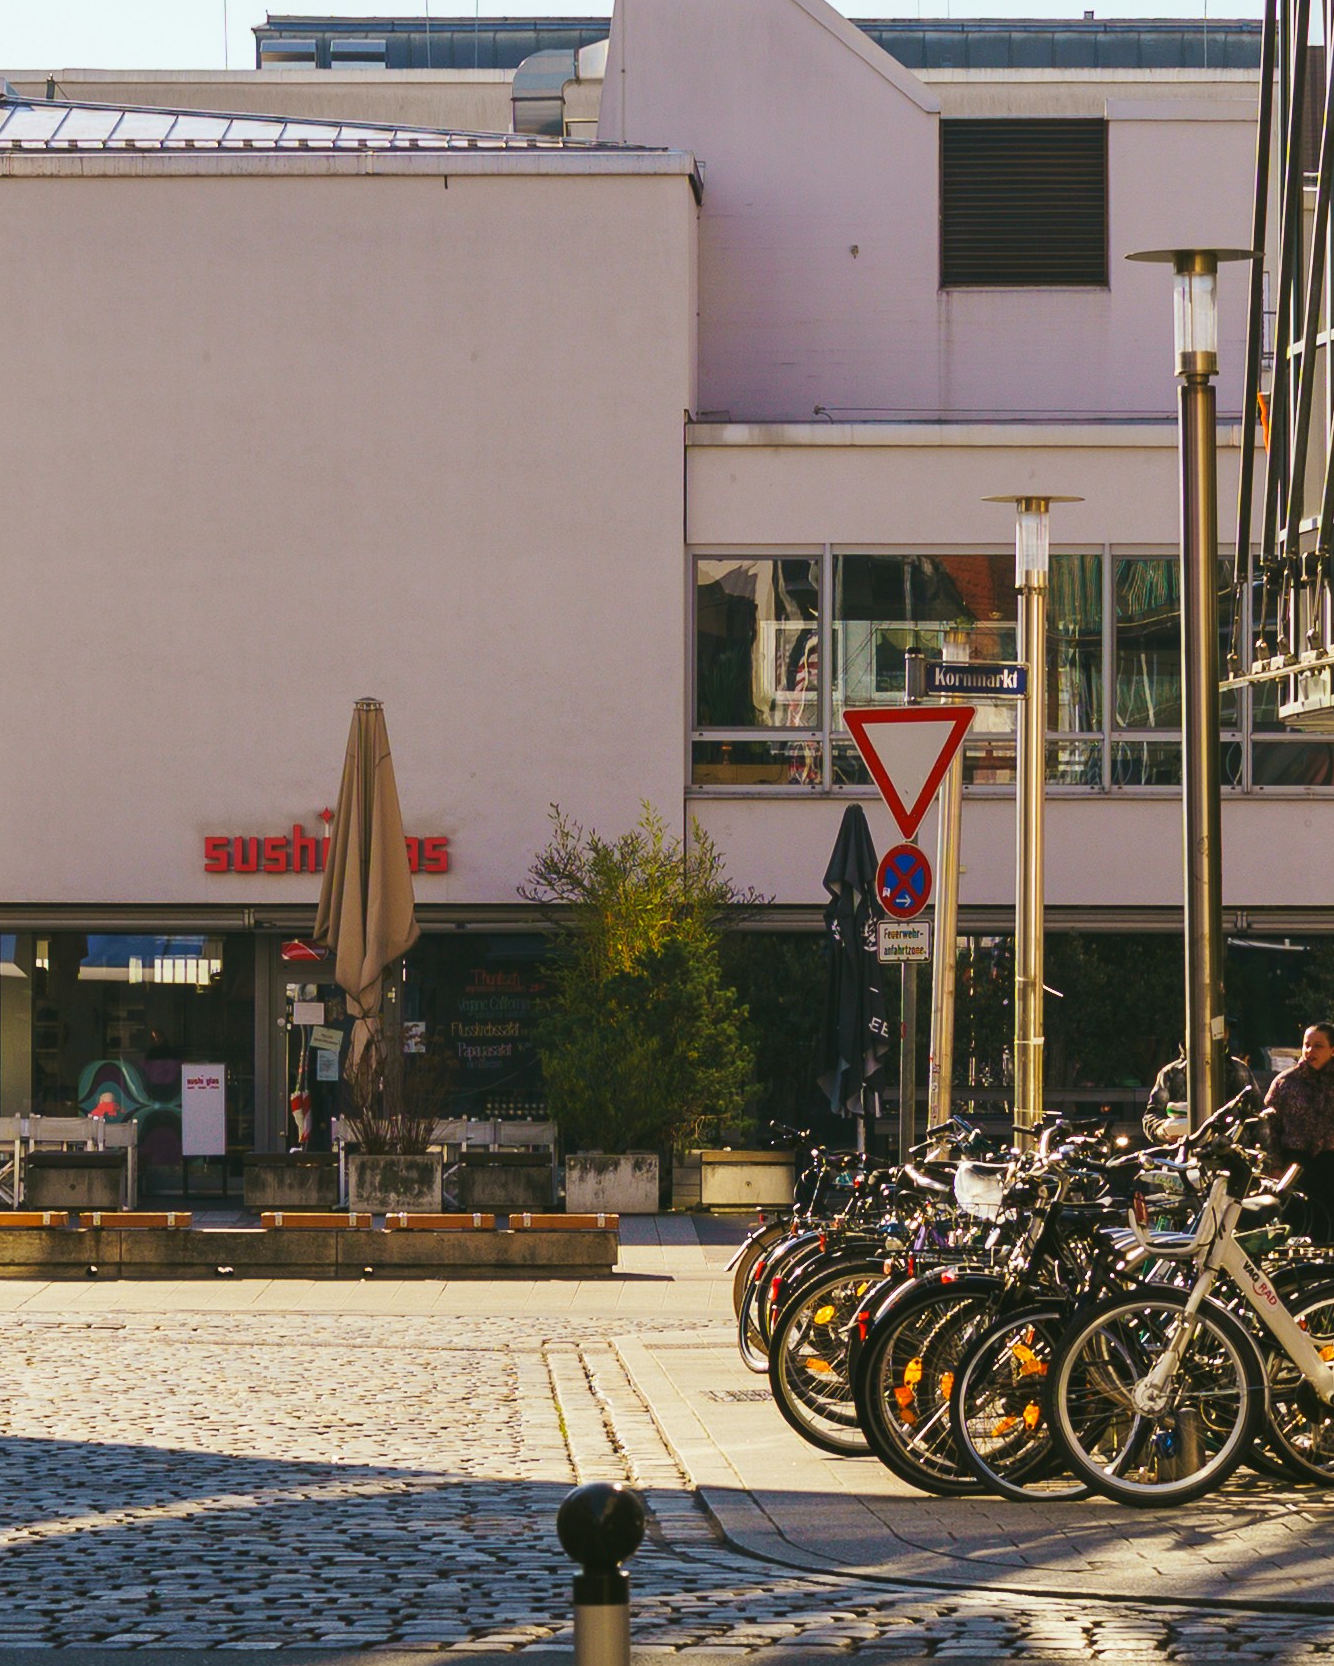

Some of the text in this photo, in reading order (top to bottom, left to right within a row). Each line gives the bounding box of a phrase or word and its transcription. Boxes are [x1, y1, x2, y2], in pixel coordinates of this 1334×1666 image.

[934, 667, 1018, 689] Kornmarkt
[204, 822, 332, 873] sushi
[1242, 1260, 1278, 1306] VAG RAD
